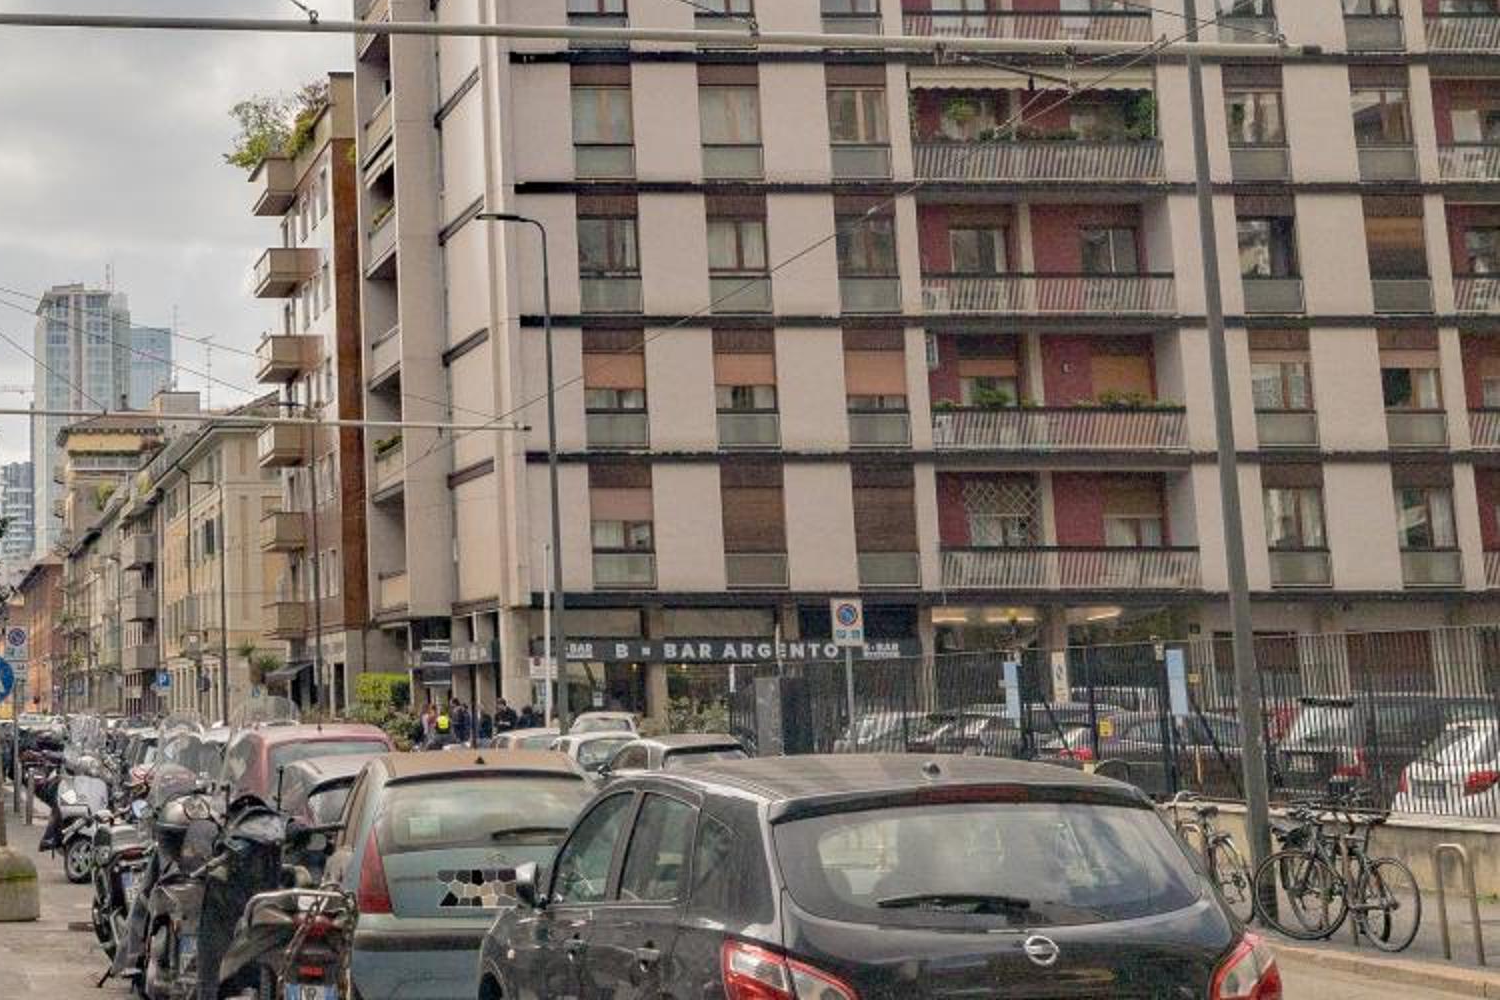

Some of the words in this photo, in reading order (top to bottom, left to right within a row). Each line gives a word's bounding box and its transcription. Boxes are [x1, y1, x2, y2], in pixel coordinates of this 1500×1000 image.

[615, 643, 629, 658] B
[664, 643, 711, 658] BAR
[722, 643, 839, 658] ARGENTO
